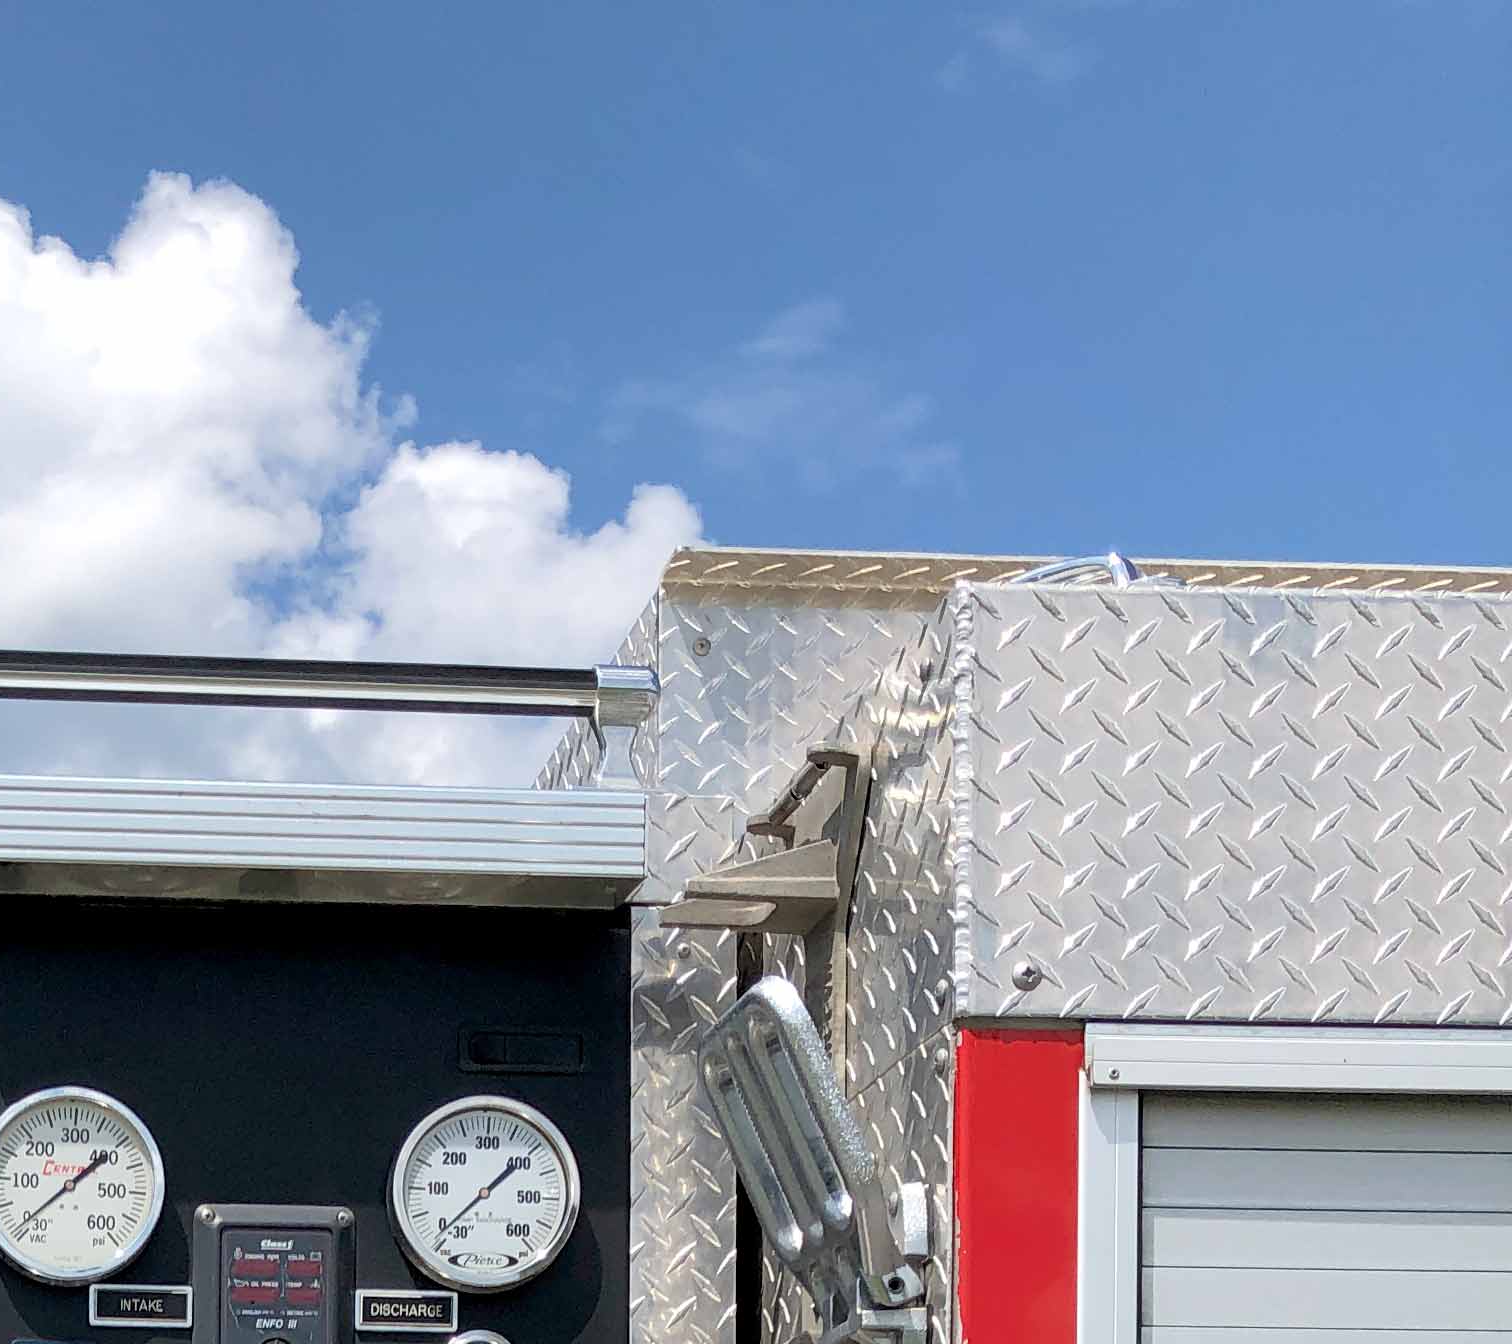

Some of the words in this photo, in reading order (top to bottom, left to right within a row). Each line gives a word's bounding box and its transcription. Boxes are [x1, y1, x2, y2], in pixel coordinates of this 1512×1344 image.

[61, 1128, 90, 1144] 300
[475, 1136, 500, 1150] 300
[25, 1142, 55, 1157] 200
[442, 1152, 467, 1165] 200
[506, 1156, 531, 1170] 400
[13, 1173, 39, 1189] 100
[97, 1184, 126, 1199] 500
[427, 1182, 449, 1196] 100
[517, 1191, 541, 1204] 500
[87, 1215, 116, 1230] 600
[506, 1224, 530, 1237] 600
[30, 1234, 46, 1243] VAC
[92, 1237, 106, 1248] psi
[463, 1254, 503, 1266] Pierce
[120, 1298, 163, 1313] INTAKE
[370, 1303, 444, 1318] DISCHARGE
[255, 1318, 284, 1329] ENFO
